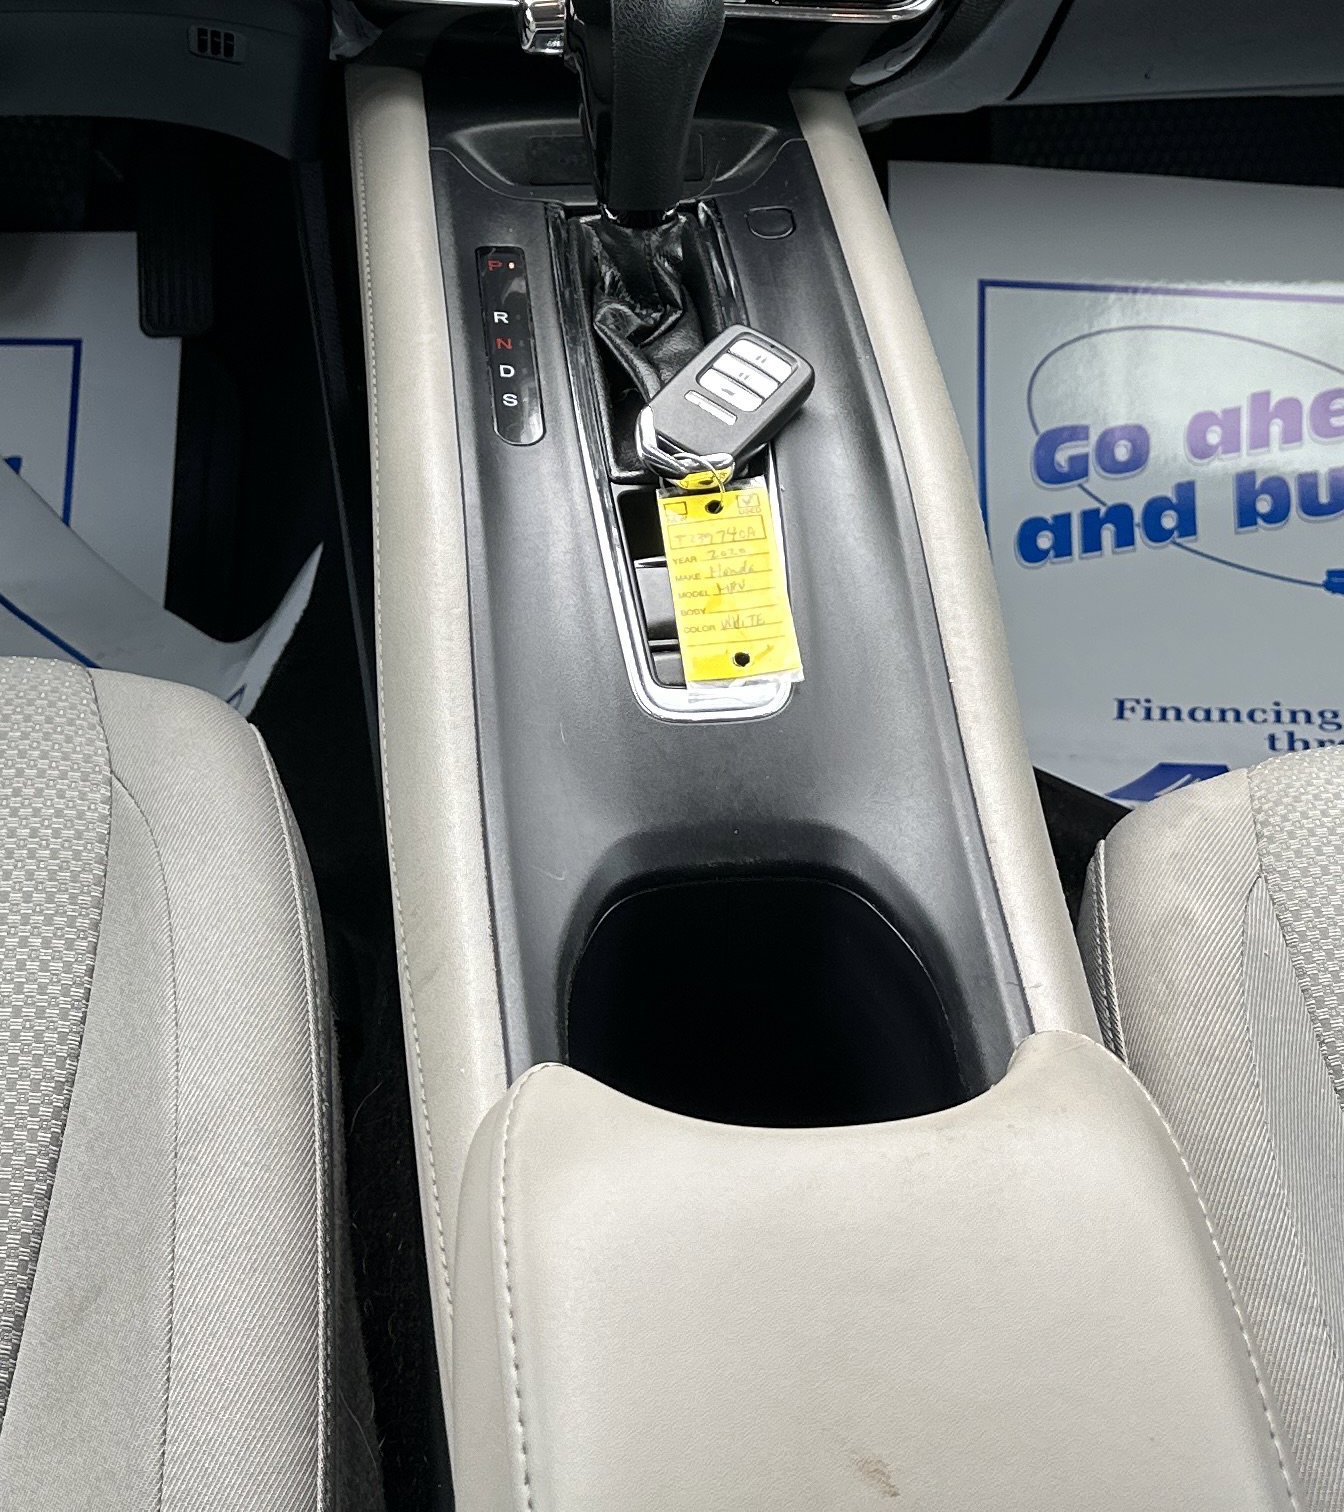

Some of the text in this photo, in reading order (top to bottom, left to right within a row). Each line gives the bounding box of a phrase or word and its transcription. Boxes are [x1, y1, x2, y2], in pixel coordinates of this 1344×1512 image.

[487, 259, 503, 271] P
[493, 311, 509, 324] R
[496, 338, 513, 350] N
[499, 364, 515, 378] D
[502, 393, 518, 407] S
[1031, 422, 1150, 489] Go
[1014, 479, 1198, 569] and
[1112, 696, 1343, 732] Financing
